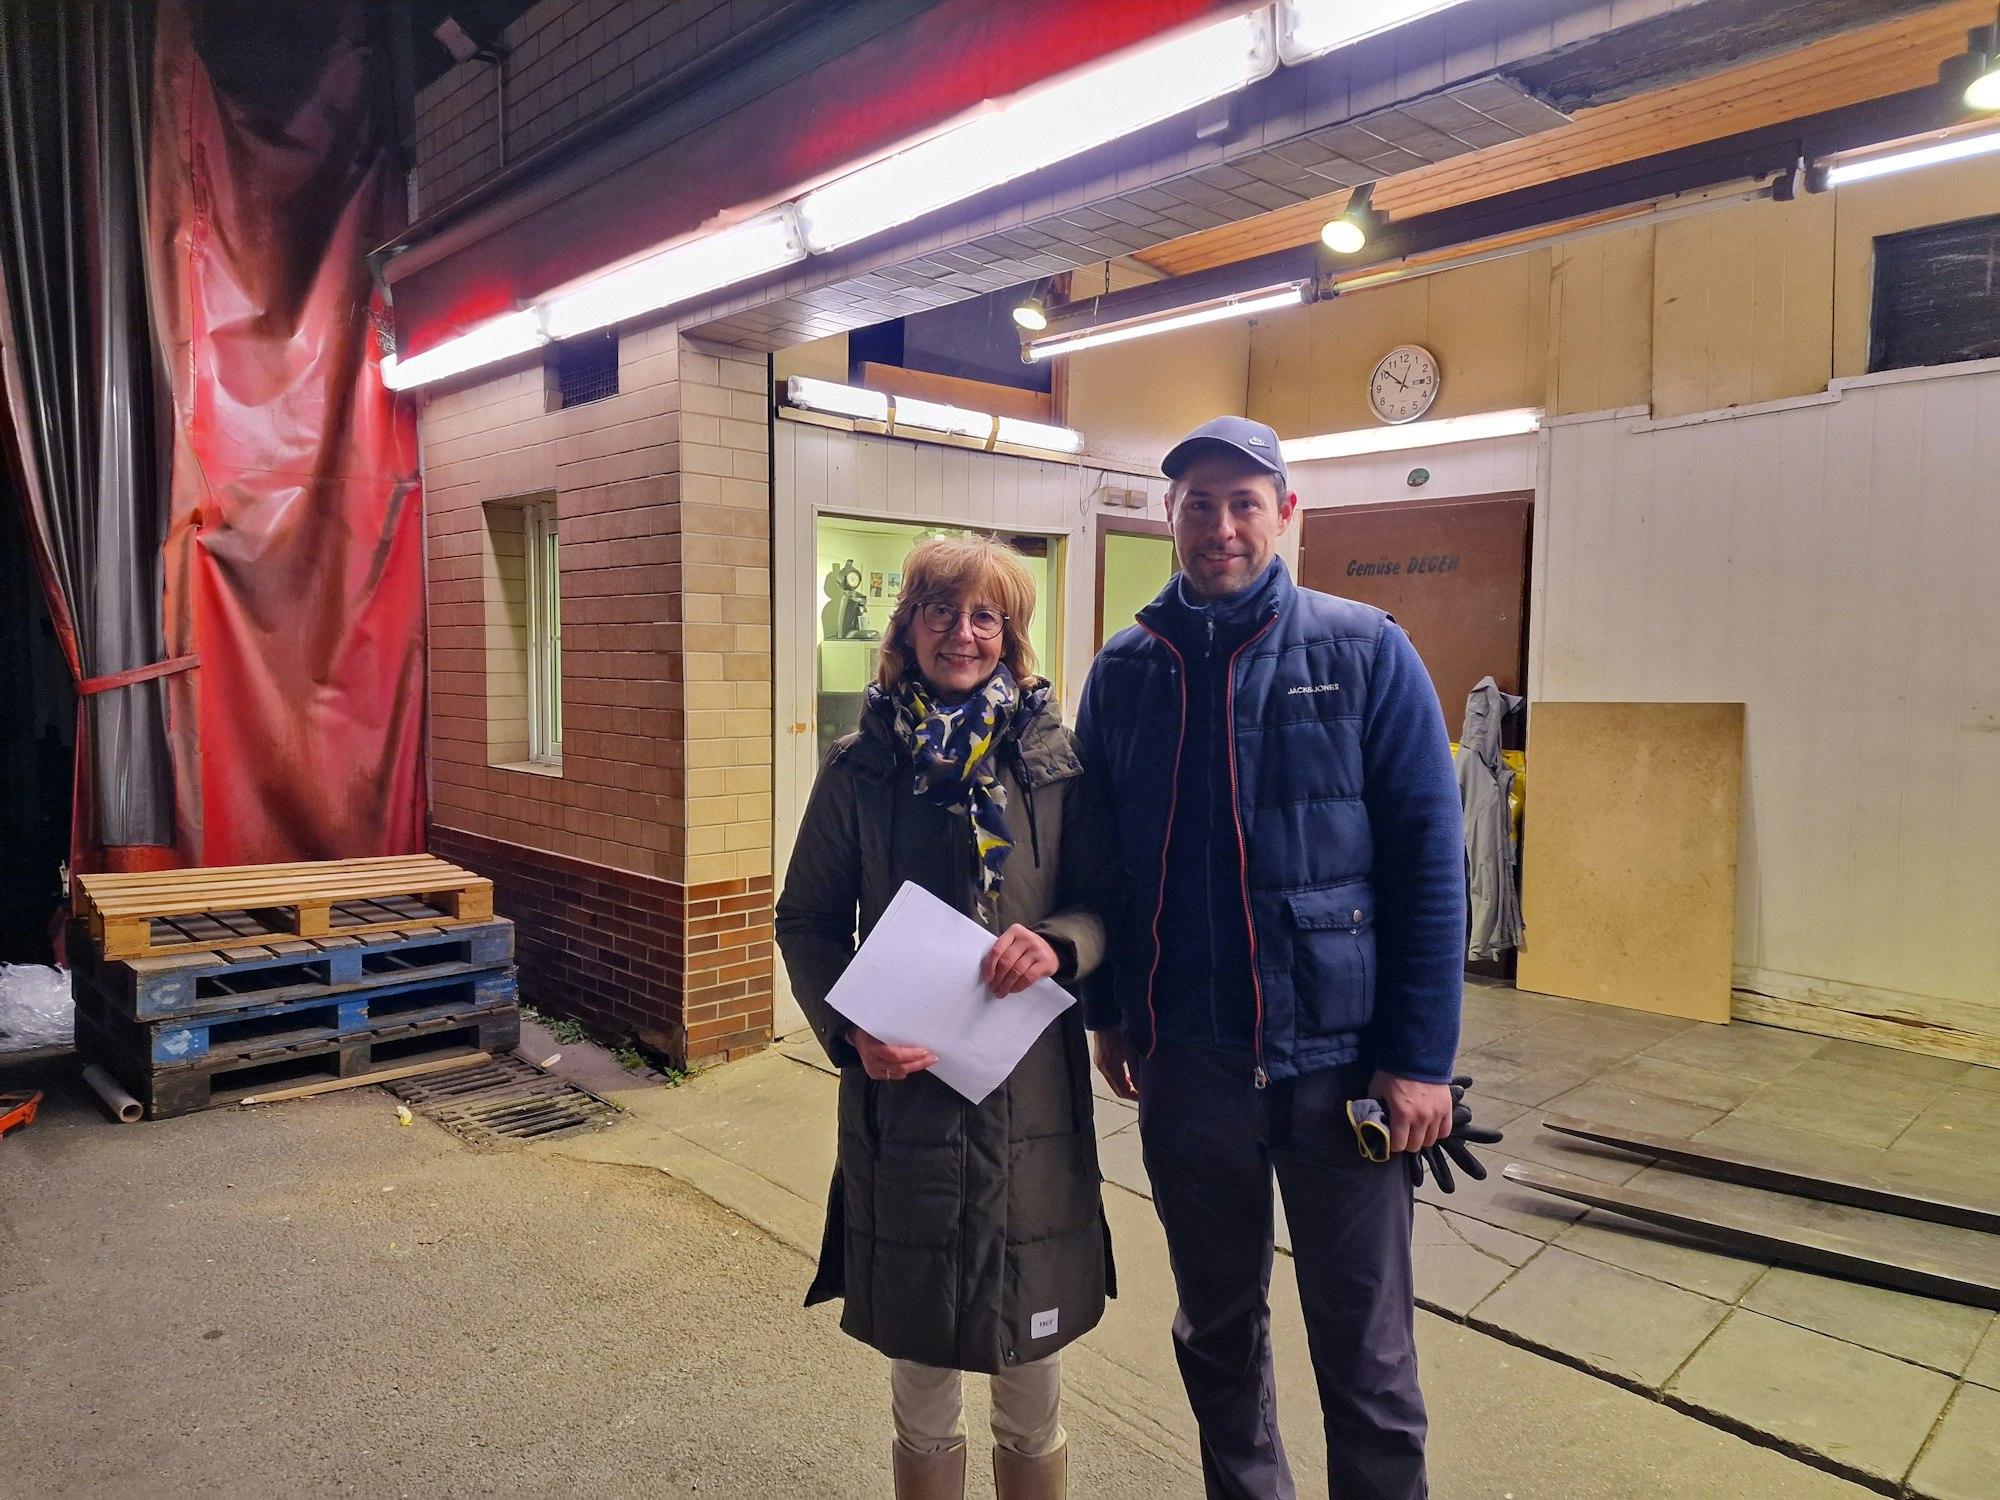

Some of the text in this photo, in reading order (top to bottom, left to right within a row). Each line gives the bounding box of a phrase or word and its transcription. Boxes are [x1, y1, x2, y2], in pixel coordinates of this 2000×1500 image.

[1400, 354, 1409, 363] 12
[1389, 361, 1397, 369] 11
[1422, 364, 1428, 373] 2
[1380, 371, 1390, 380] 10
[1426, 376, 1432, 385] 3
[1376, 385, 1382, 394] 9
[1422, 390, 1427, 399] 4
[1380, 397, 1386, 406] 8
[1413, 401, 1418, 410] 5
[1389, 405, 1395, 414] 7
[1401, 407, 1406, 415] 6
[1347, 556, 1401, 576] Gemüse
